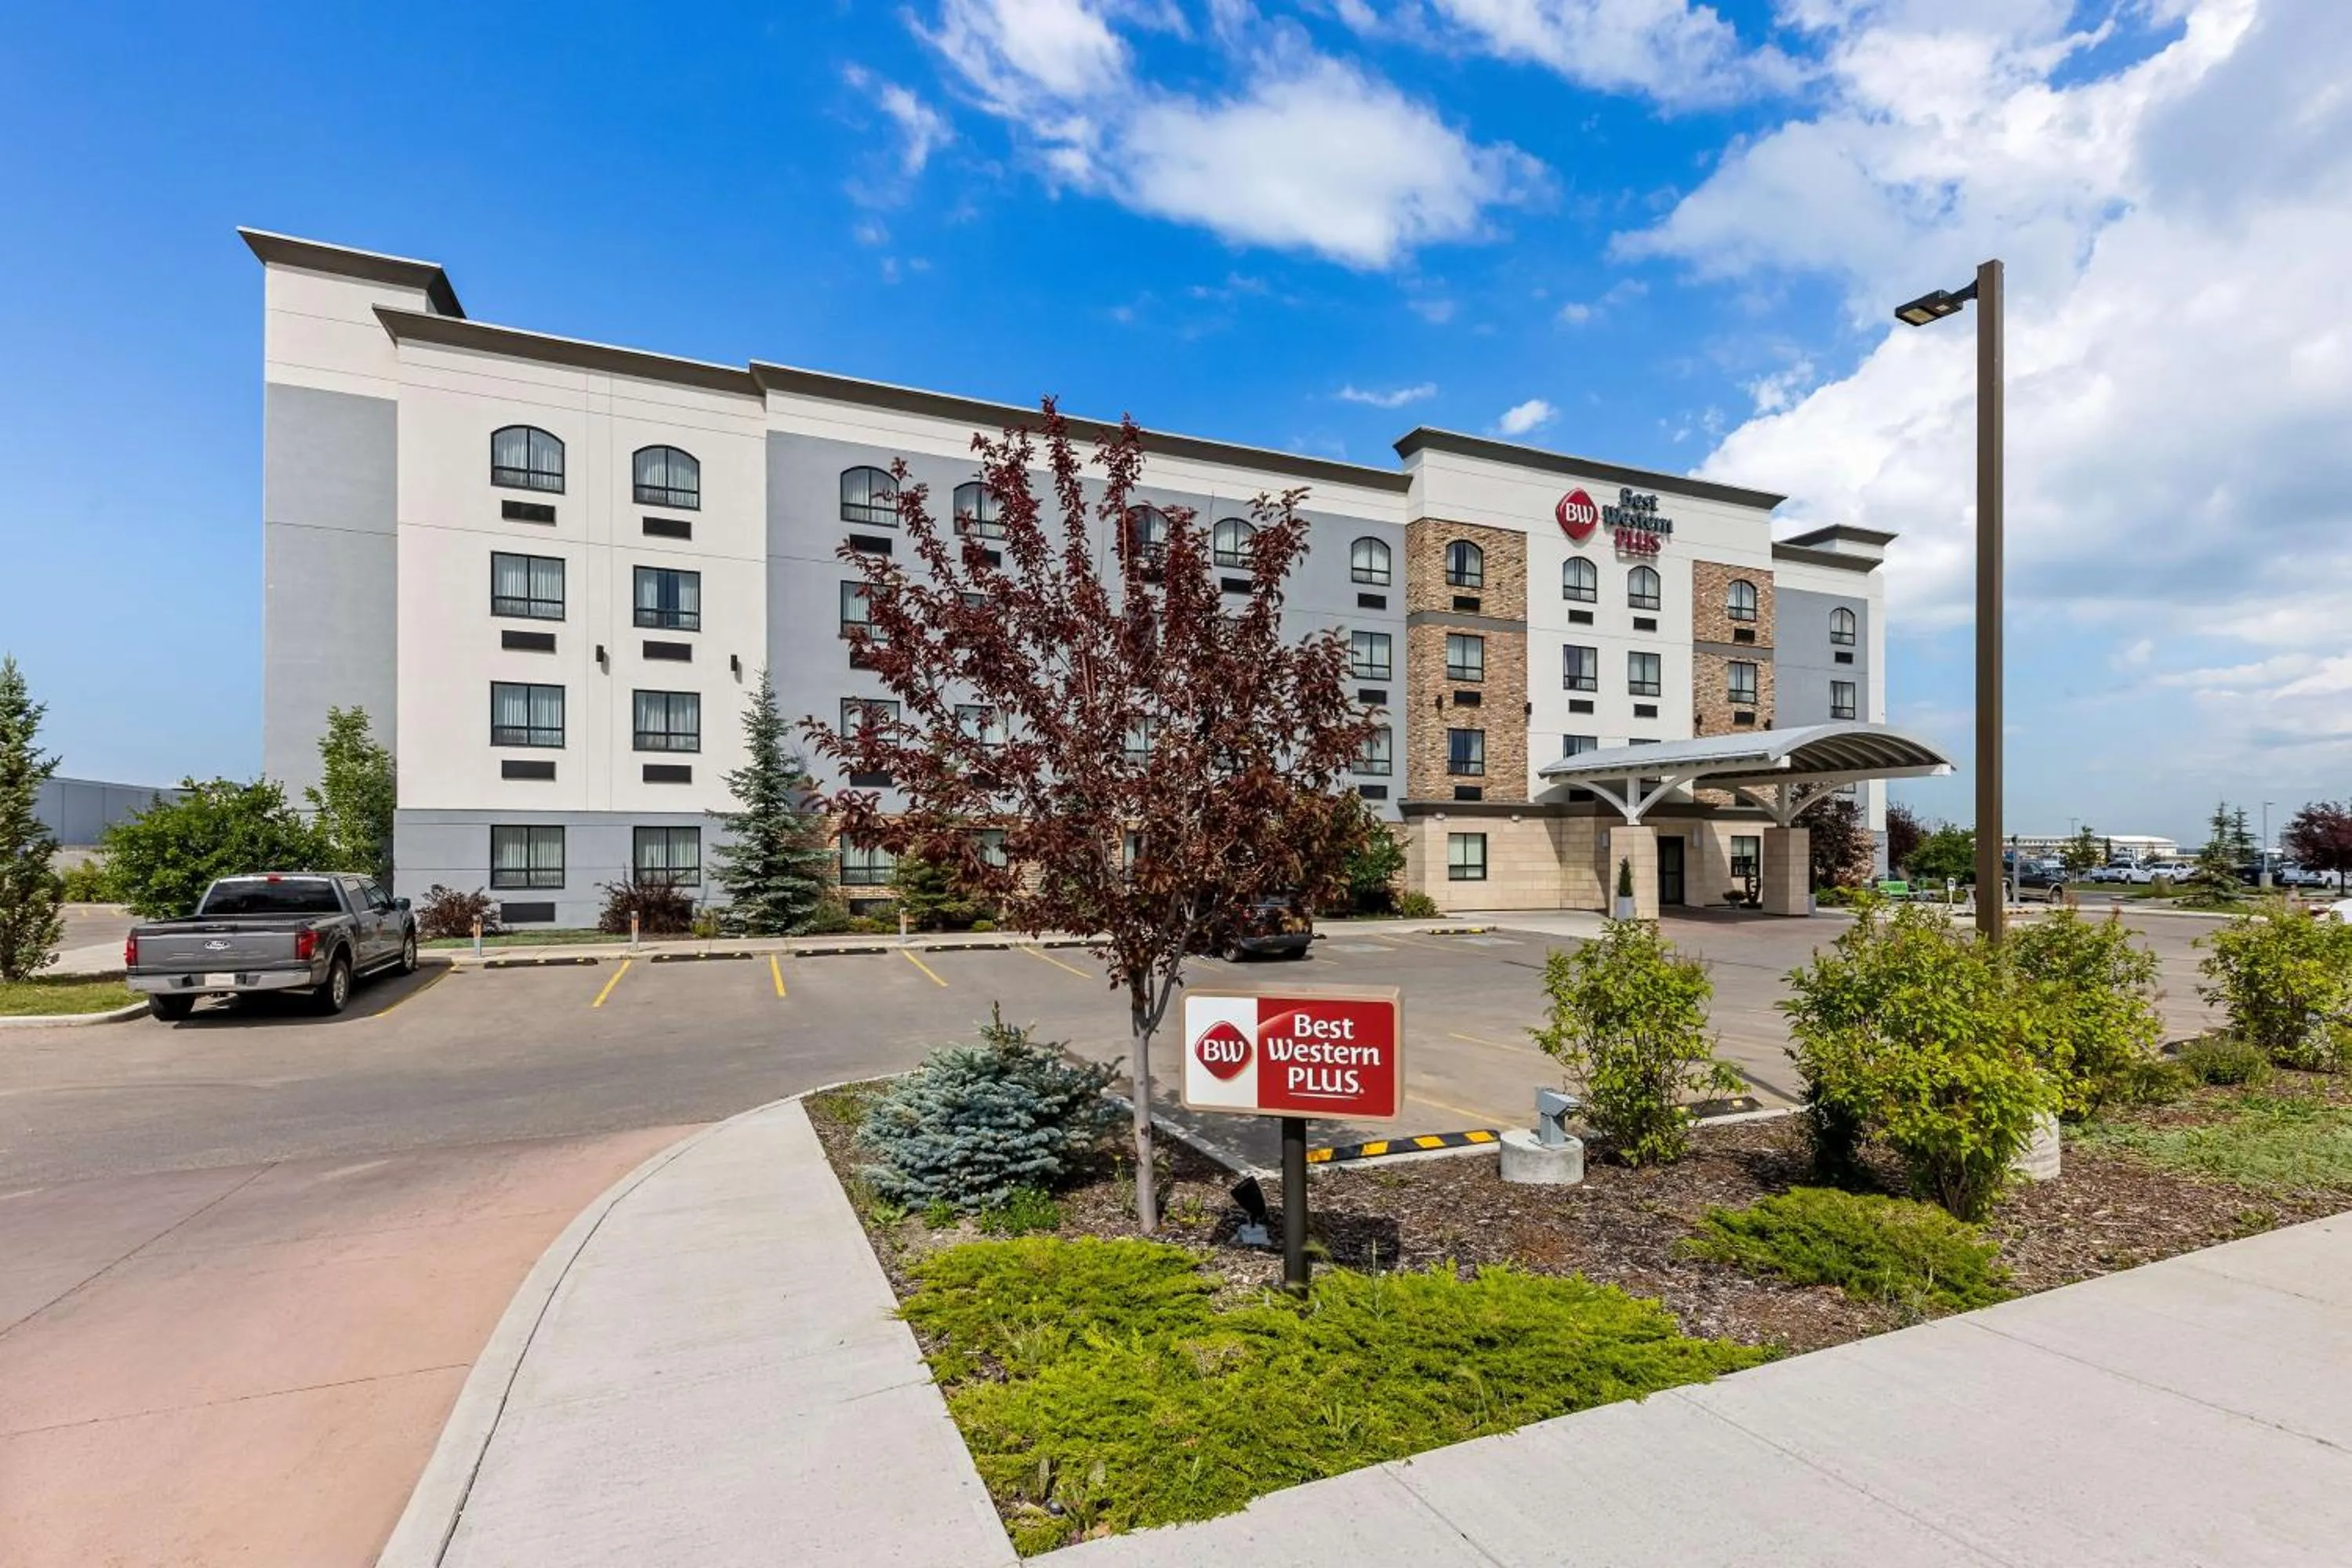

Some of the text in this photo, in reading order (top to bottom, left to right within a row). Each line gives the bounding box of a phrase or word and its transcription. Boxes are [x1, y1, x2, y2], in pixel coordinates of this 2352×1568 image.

[1619, 487, 1659, 511] Best
[1565, 503, 1594, 524] BW
[1602, 504, 1674, 534] Western
[1614, 528, 1661, 553] PLUS
[1294, 1014, 1355, 1040] Best
[1203, 1039, 1245, 1063] BW
[1267, 1037, 1381, 1066] Western
